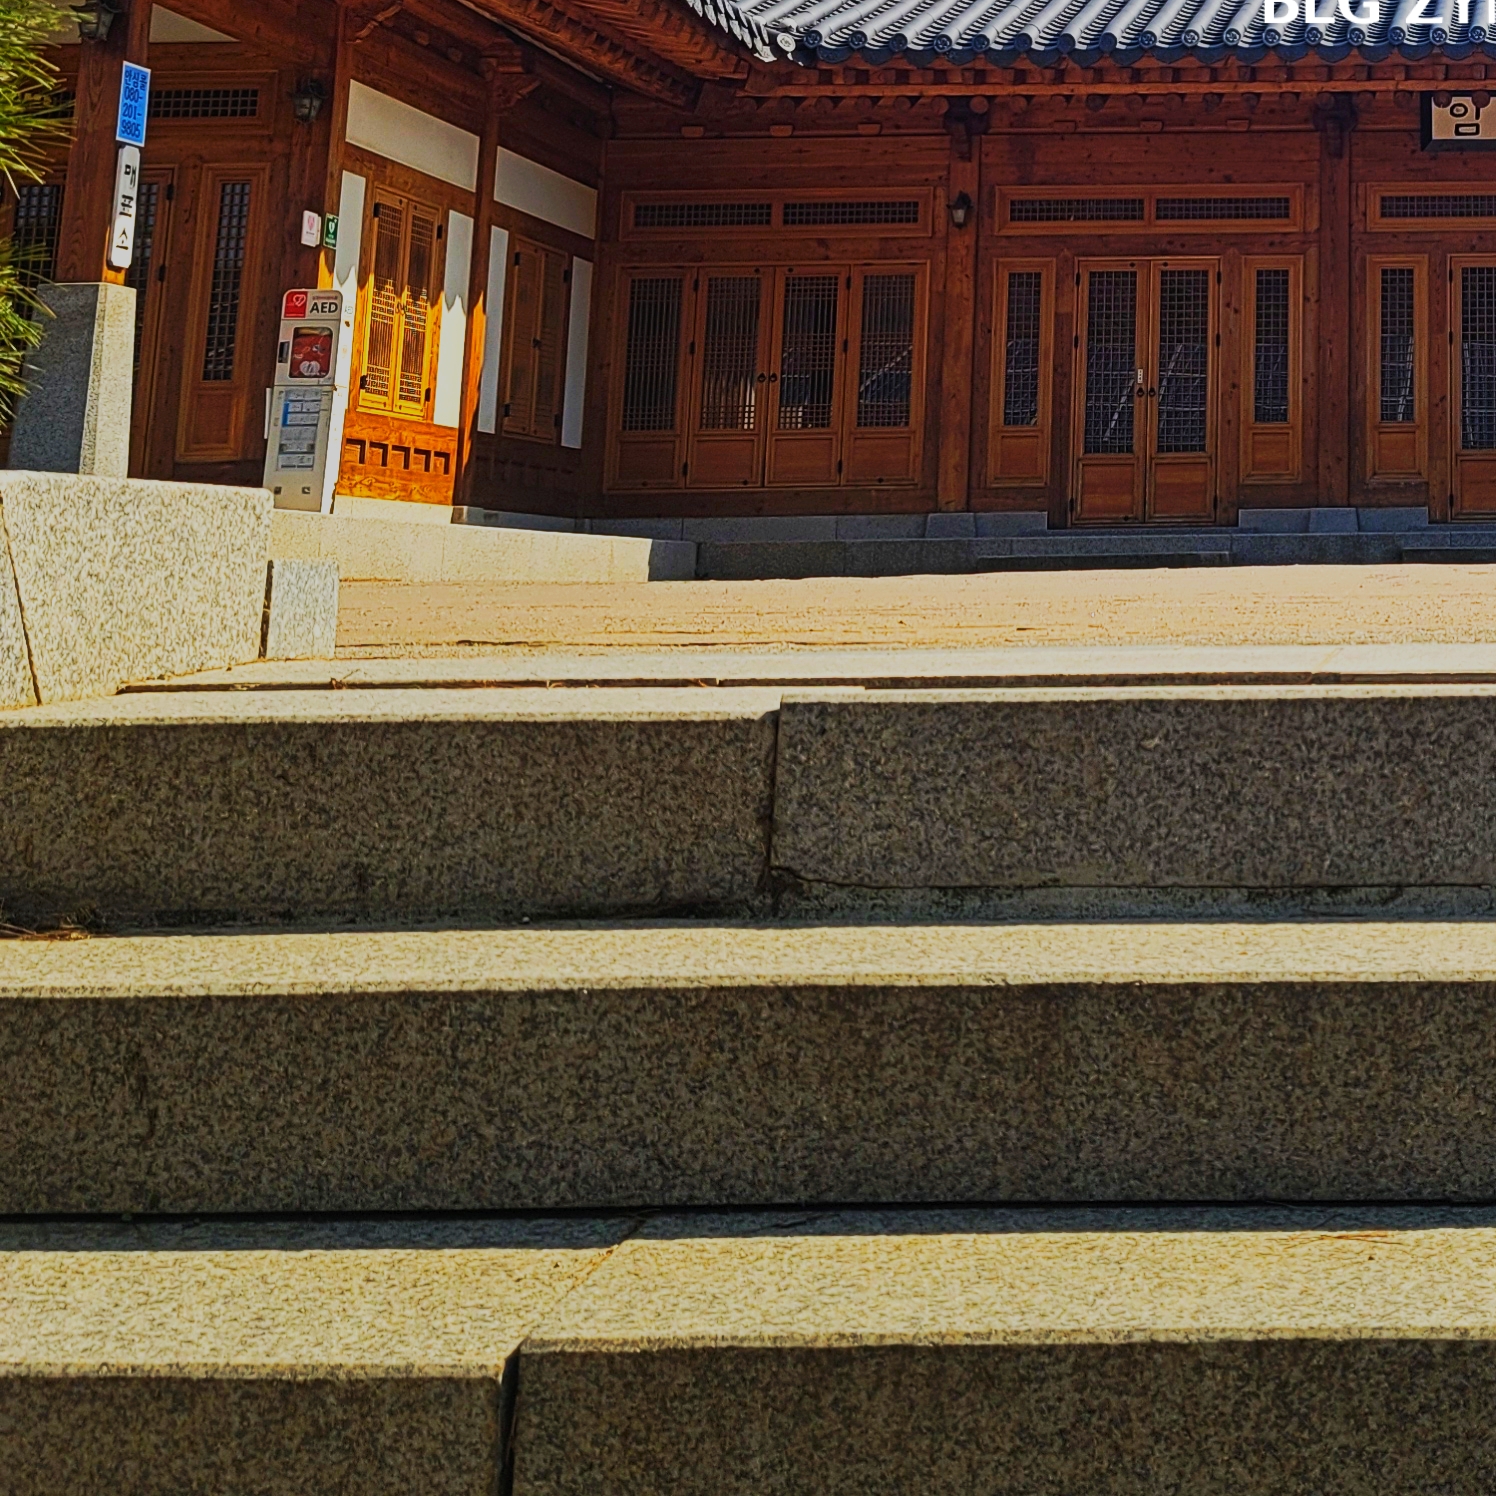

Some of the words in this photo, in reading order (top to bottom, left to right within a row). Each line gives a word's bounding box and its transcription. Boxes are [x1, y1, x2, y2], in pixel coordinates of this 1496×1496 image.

[124, 70, 147, 91] 안심콜
[123, 86, 143, 103] 080-
[122, 103, 142, 120] 201-
[120, 119, 141, 138] 9805
[115, 164, 138, 251] 매표소
[309, 301, 339, 314] AED
